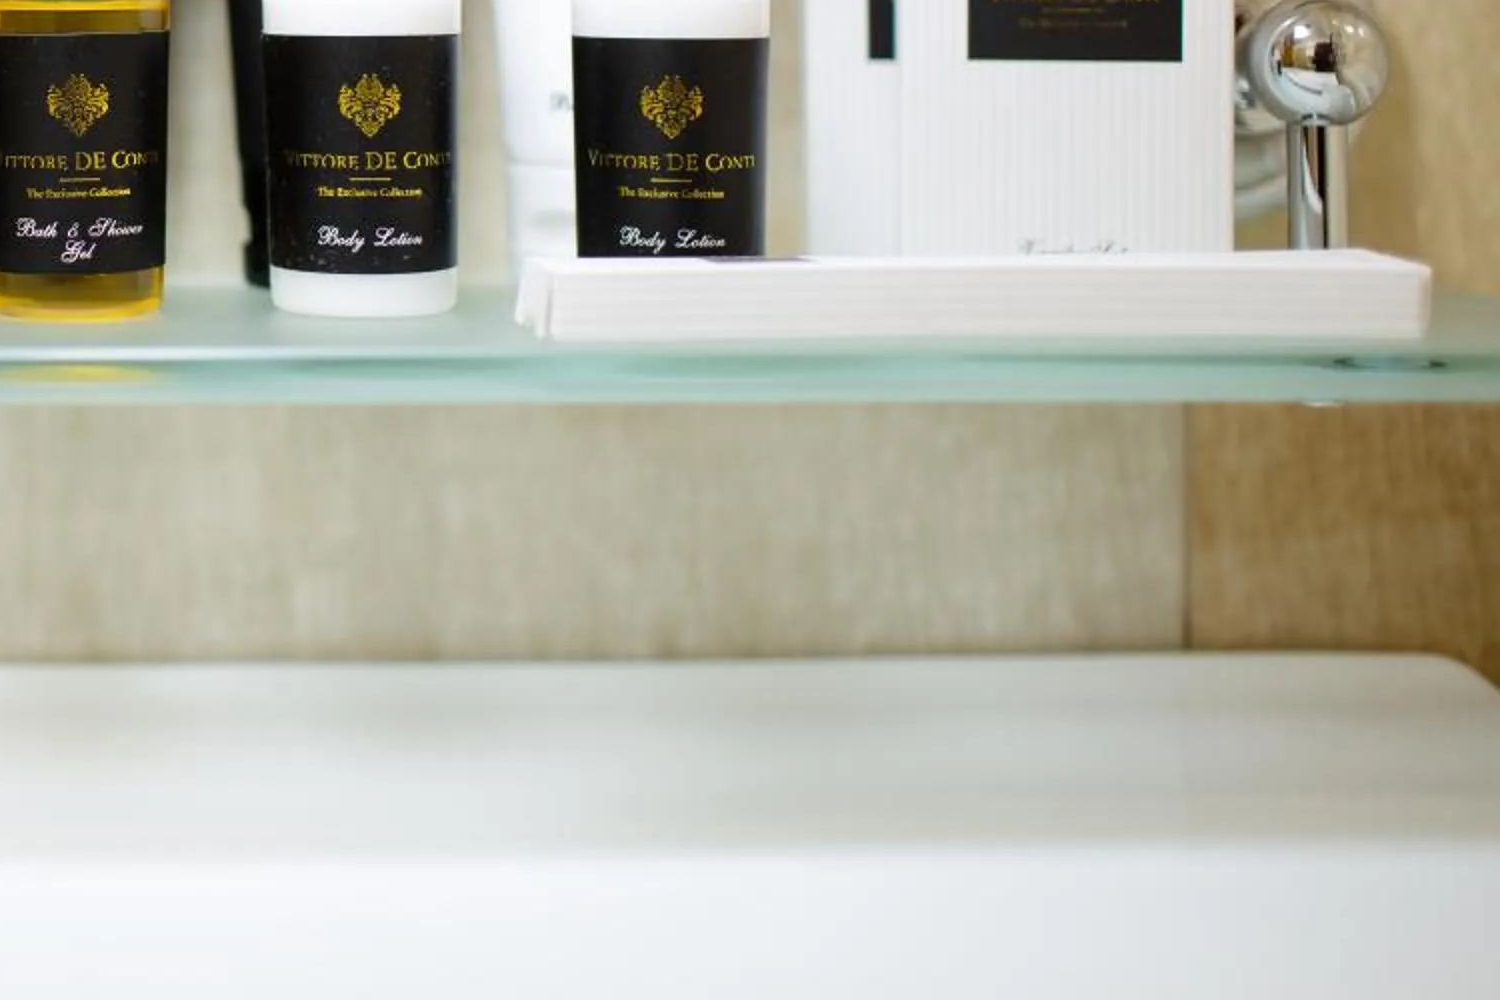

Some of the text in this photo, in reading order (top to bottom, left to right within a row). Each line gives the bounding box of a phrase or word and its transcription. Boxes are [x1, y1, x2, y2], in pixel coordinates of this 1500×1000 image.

[75, 152, 106, 170] DE
[364, 151, 397, 170] DE
[587, 150, 756, 172] VITTORE DE CONTI
[26, 187, 43, 199] The
[317, 186, 334, 197] The
[619, 187, 636, 198] The
[14, 217, 144, 239] Bath & Shower
[317, 225, 423, 253] Body Lotion
[619, 225, 726, 254] Body Lotion
[60, 240, 96, 263] Gel
